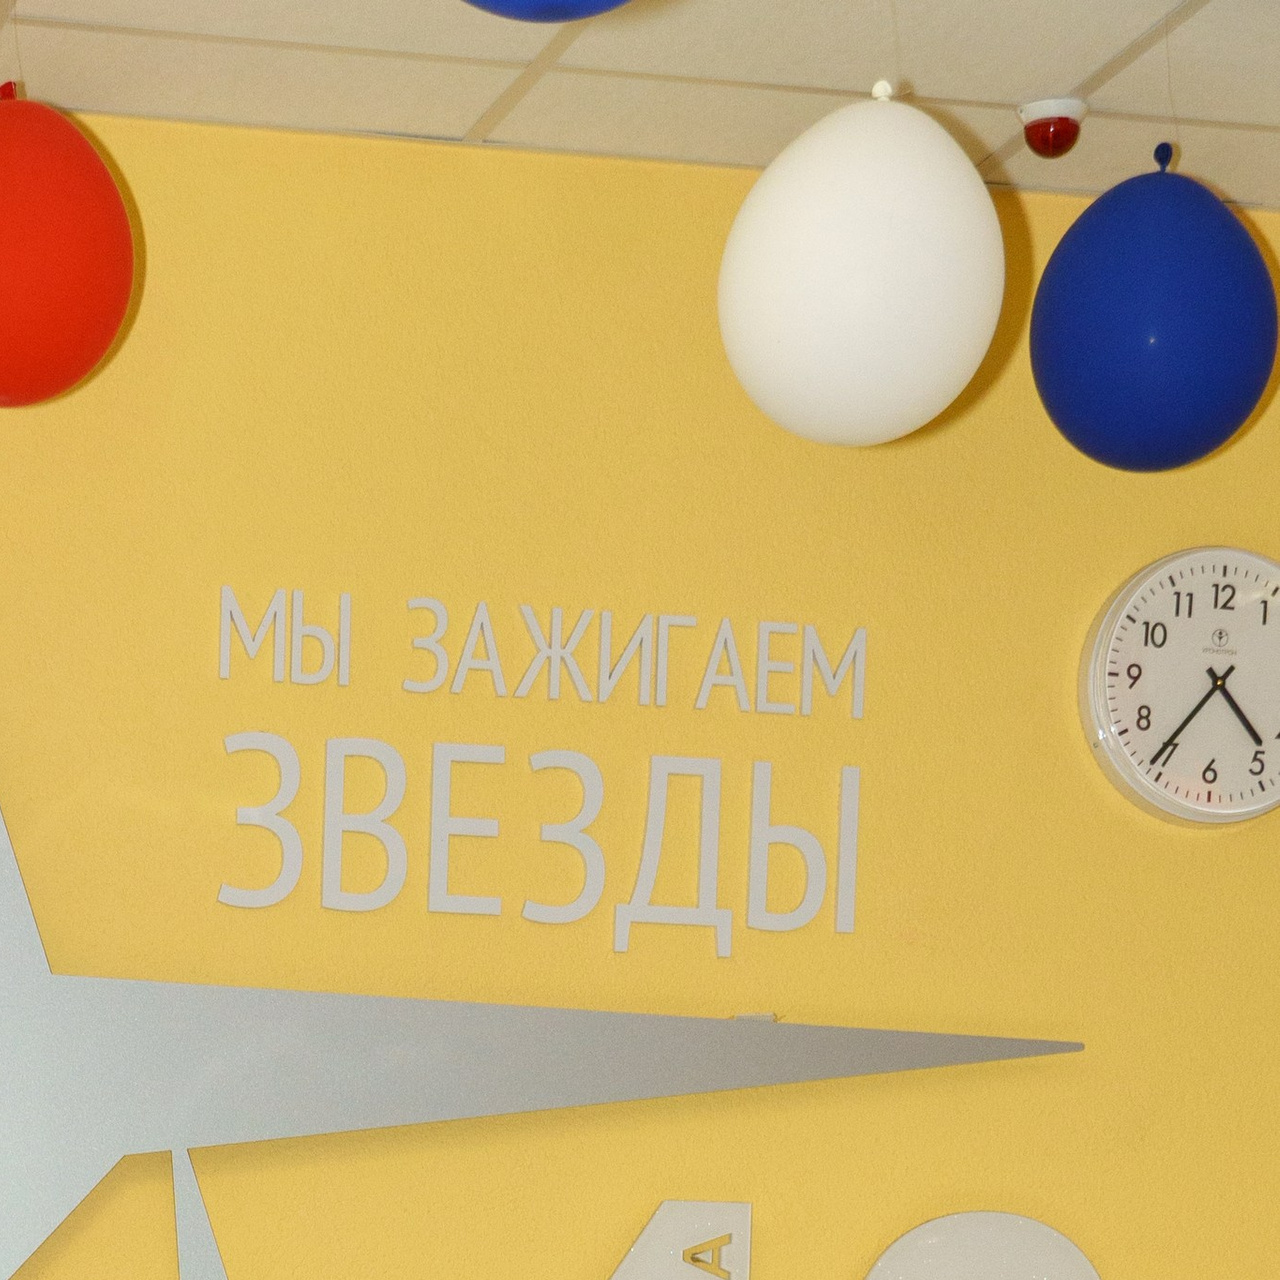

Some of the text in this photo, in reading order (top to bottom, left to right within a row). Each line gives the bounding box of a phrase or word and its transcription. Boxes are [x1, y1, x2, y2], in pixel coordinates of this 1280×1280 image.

[1173, 591, 1194, 618] 11
[1212, 584, 1236, 610] 12
[1260, 600, 1268, 625] 1
[1142, 621, 1168, 648] 10
[219, 585, 867, 719] МЫ ЗАЖИГАЕМ
[1126, 663, 1142, 689] 9
[1136, 705, 1151, 731] 8
[1201, 758, 1217, 784] 6
[1248, 750, 1265, 776] 5
[217, 731, 861, 958] ЗВЕЗДЫ
